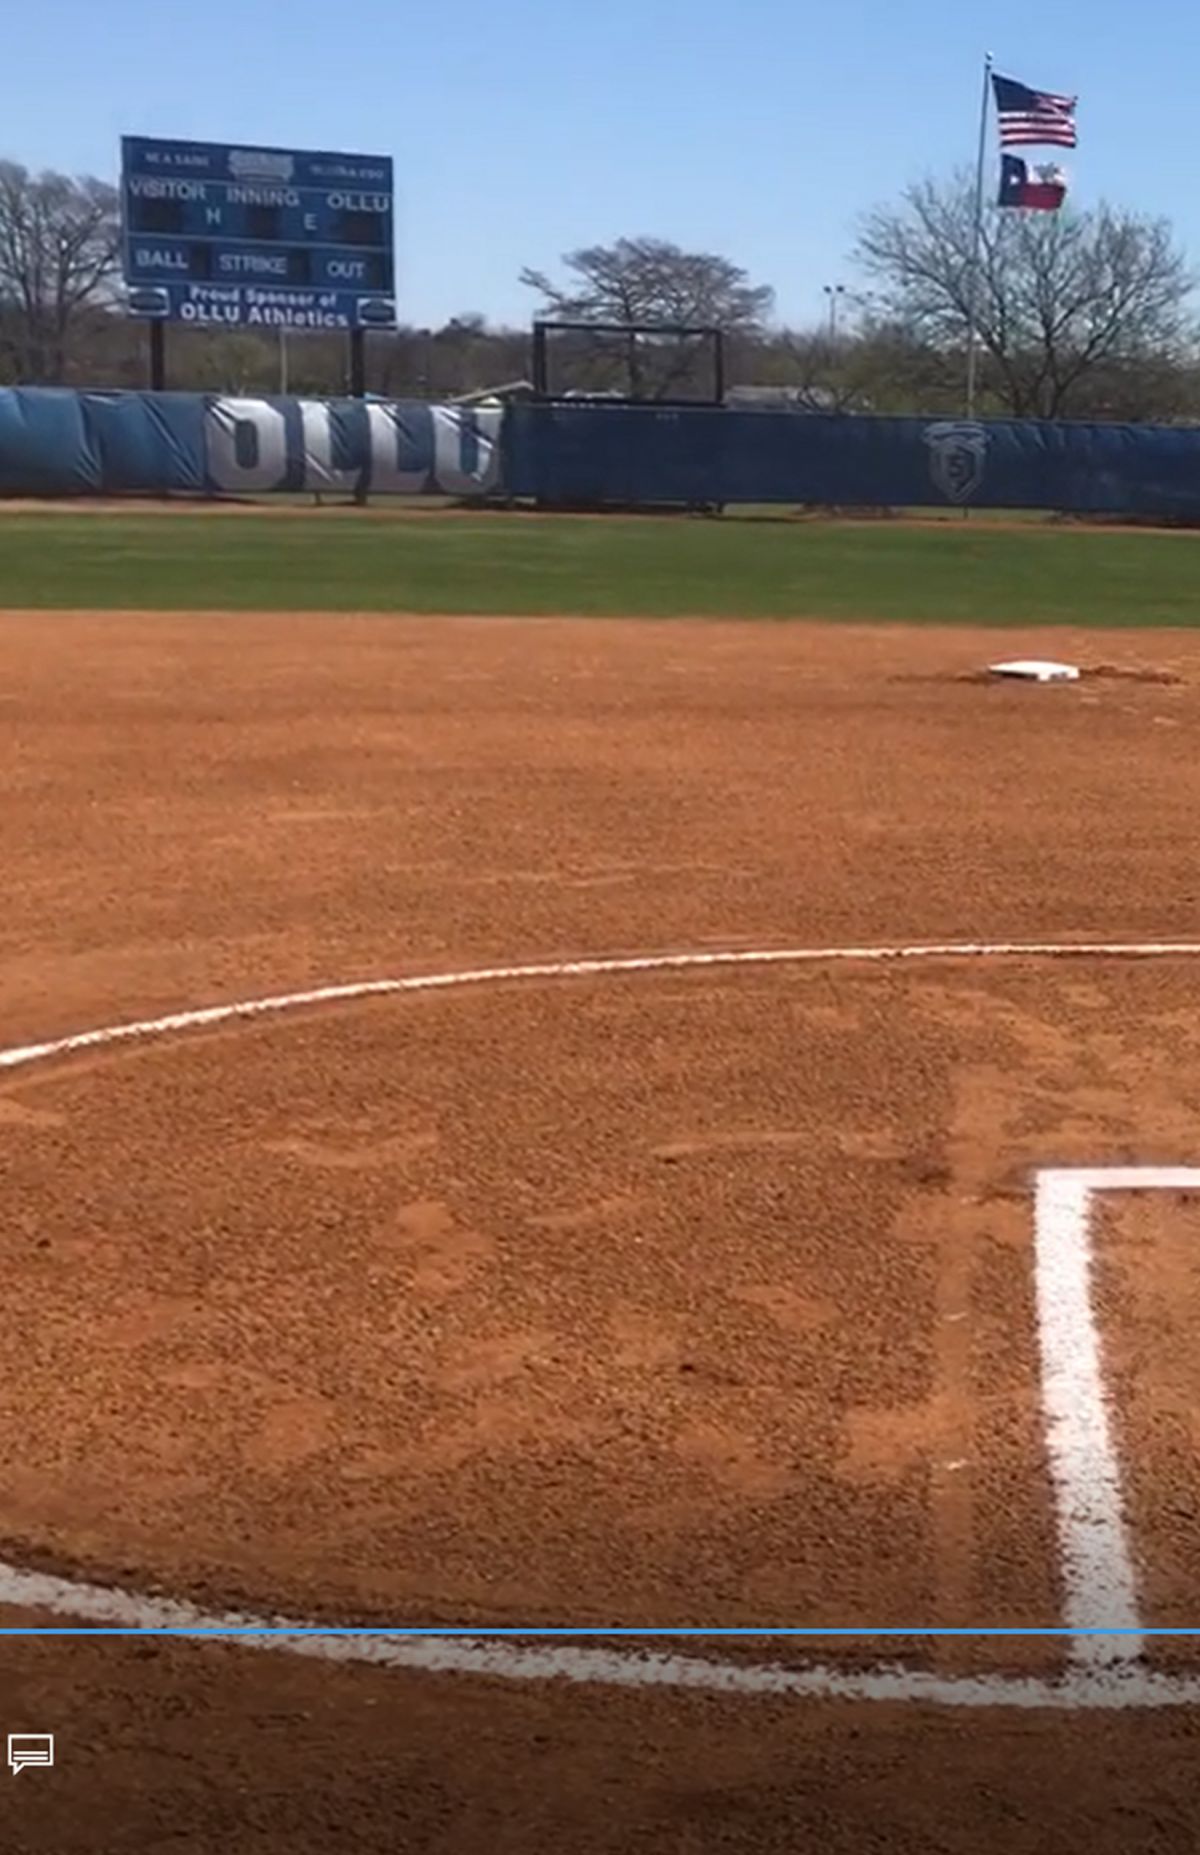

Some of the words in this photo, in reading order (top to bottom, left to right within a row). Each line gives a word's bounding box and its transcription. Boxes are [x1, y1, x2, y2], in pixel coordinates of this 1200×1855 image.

[128, 180, 206, 201] VISITOR
[226, 188, 301, 207] INNING
[326, 193, 390, 213] OLLU
[304, 214, 316, 230] E
[136, 250, 189, 270] BALL
[219, 253, 287, 274] STRIKE
[327, 261, 366, 279] OUT
[189, 286, 239, 303] Proud
[245, 287, 313, 307] Sponsor
[319, 293, 337, 307] of
[180, 302, 240, 323] OLLU
[248, 306, 349, 328] Athletics
[205, 397, 502, 492] OLLU
